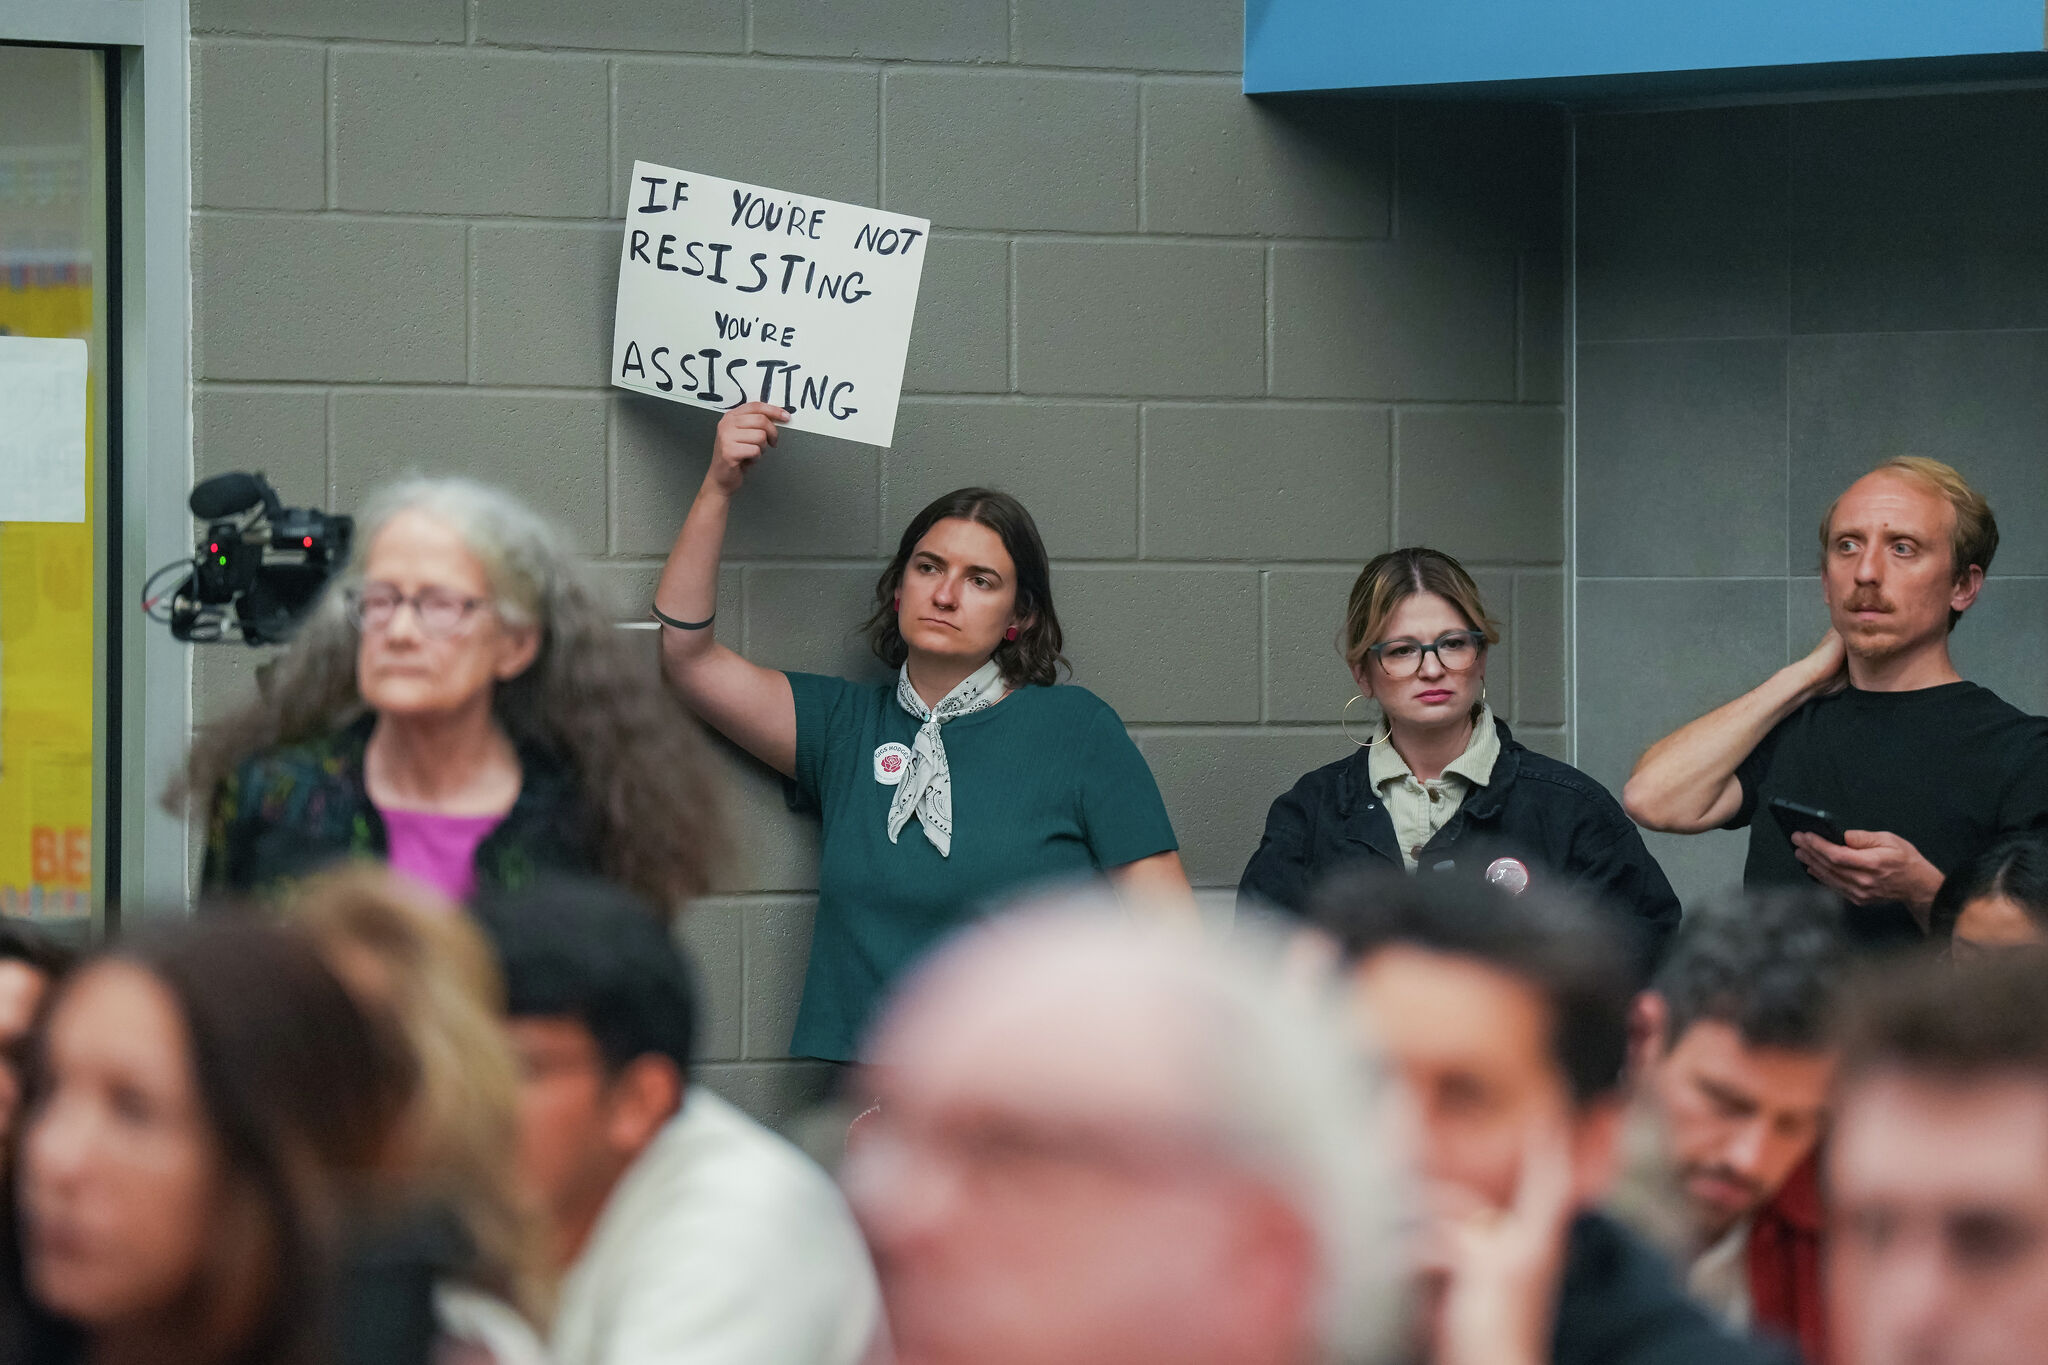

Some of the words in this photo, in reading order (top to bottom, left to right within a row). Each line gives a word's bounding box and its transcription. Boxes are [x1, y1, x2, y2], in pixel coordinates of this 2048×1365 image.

[638, 176, 689, 213] IF
[731, 189, 826, 239] YOU'RE
[853, 223, 923, 255] NOT
[630, 230, 872, 304] RESISTING
[714, 310, 796, 347] YOU'RE
[621, 340, 858, 420] ASSISTING
